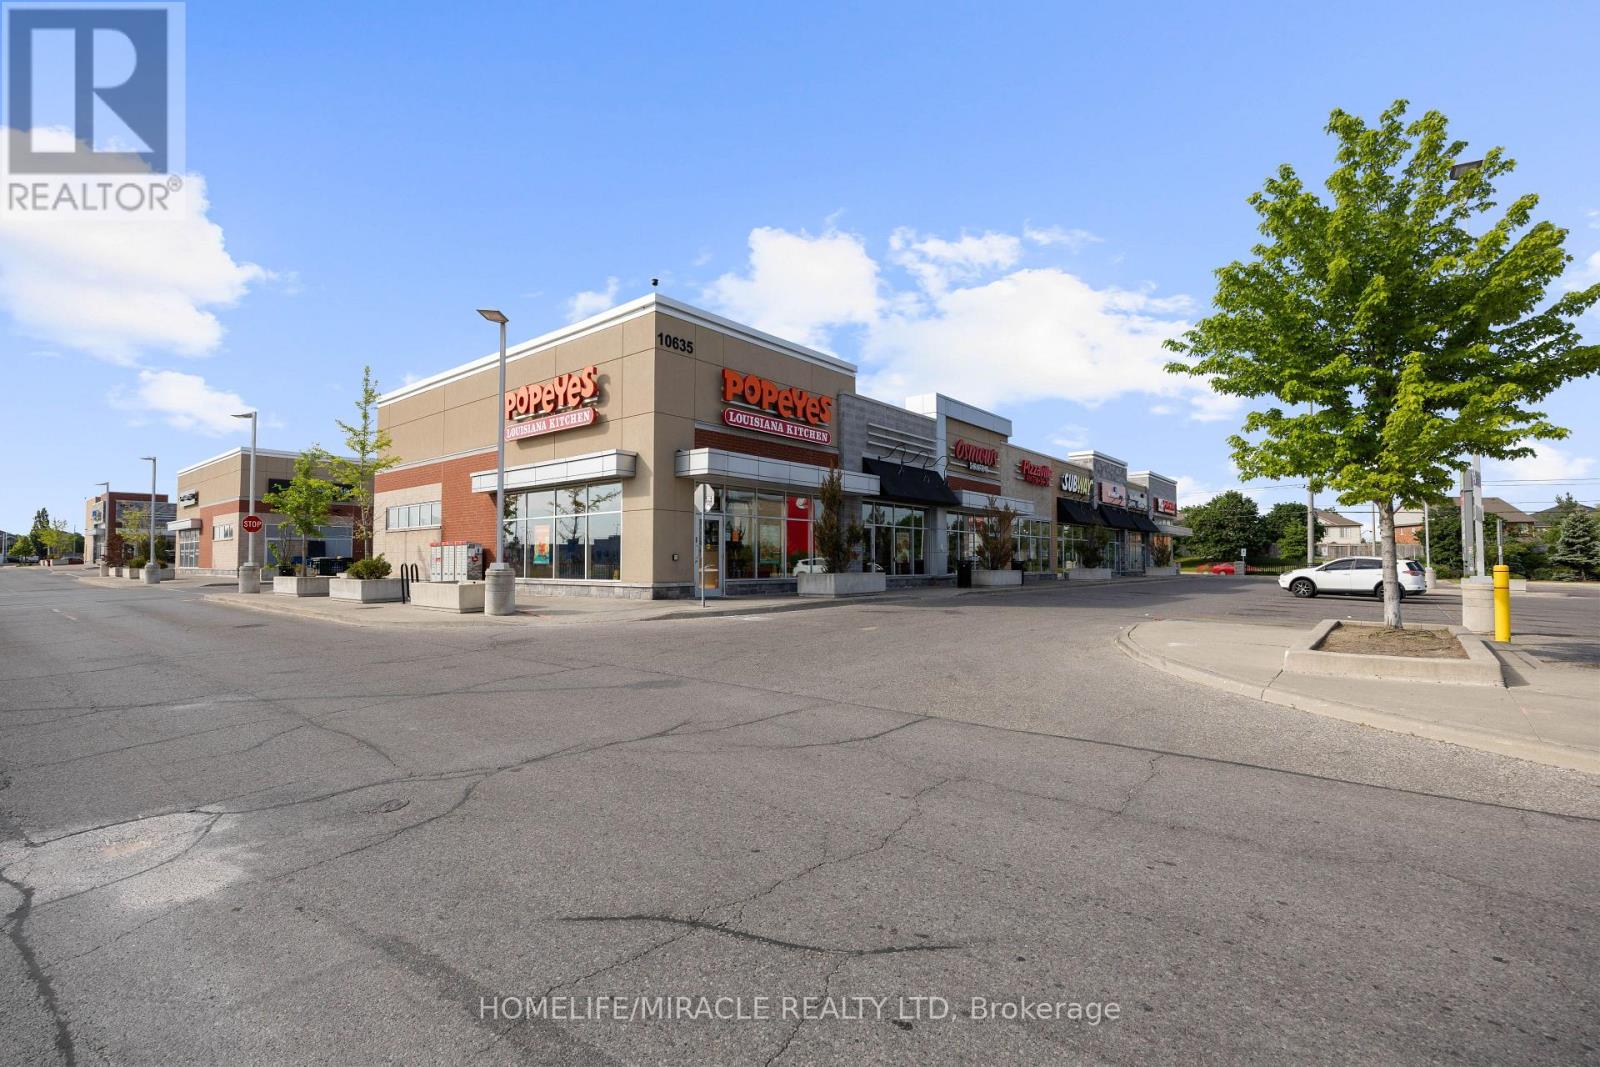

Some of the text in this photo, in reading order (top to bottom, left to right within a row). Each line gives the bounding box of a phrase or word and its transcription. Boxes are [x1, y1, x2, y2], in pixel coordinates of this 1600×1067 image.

[657, 332, 694, 354] 10635
[505, 410, 591, 439] LOUISIANA KITCHEN
[728, 411, 829, 443] LOUISIANA KITCHEN
[1061, 472, 1093, 496] SUBWAY
[243, 520, 262, 528] STOP
